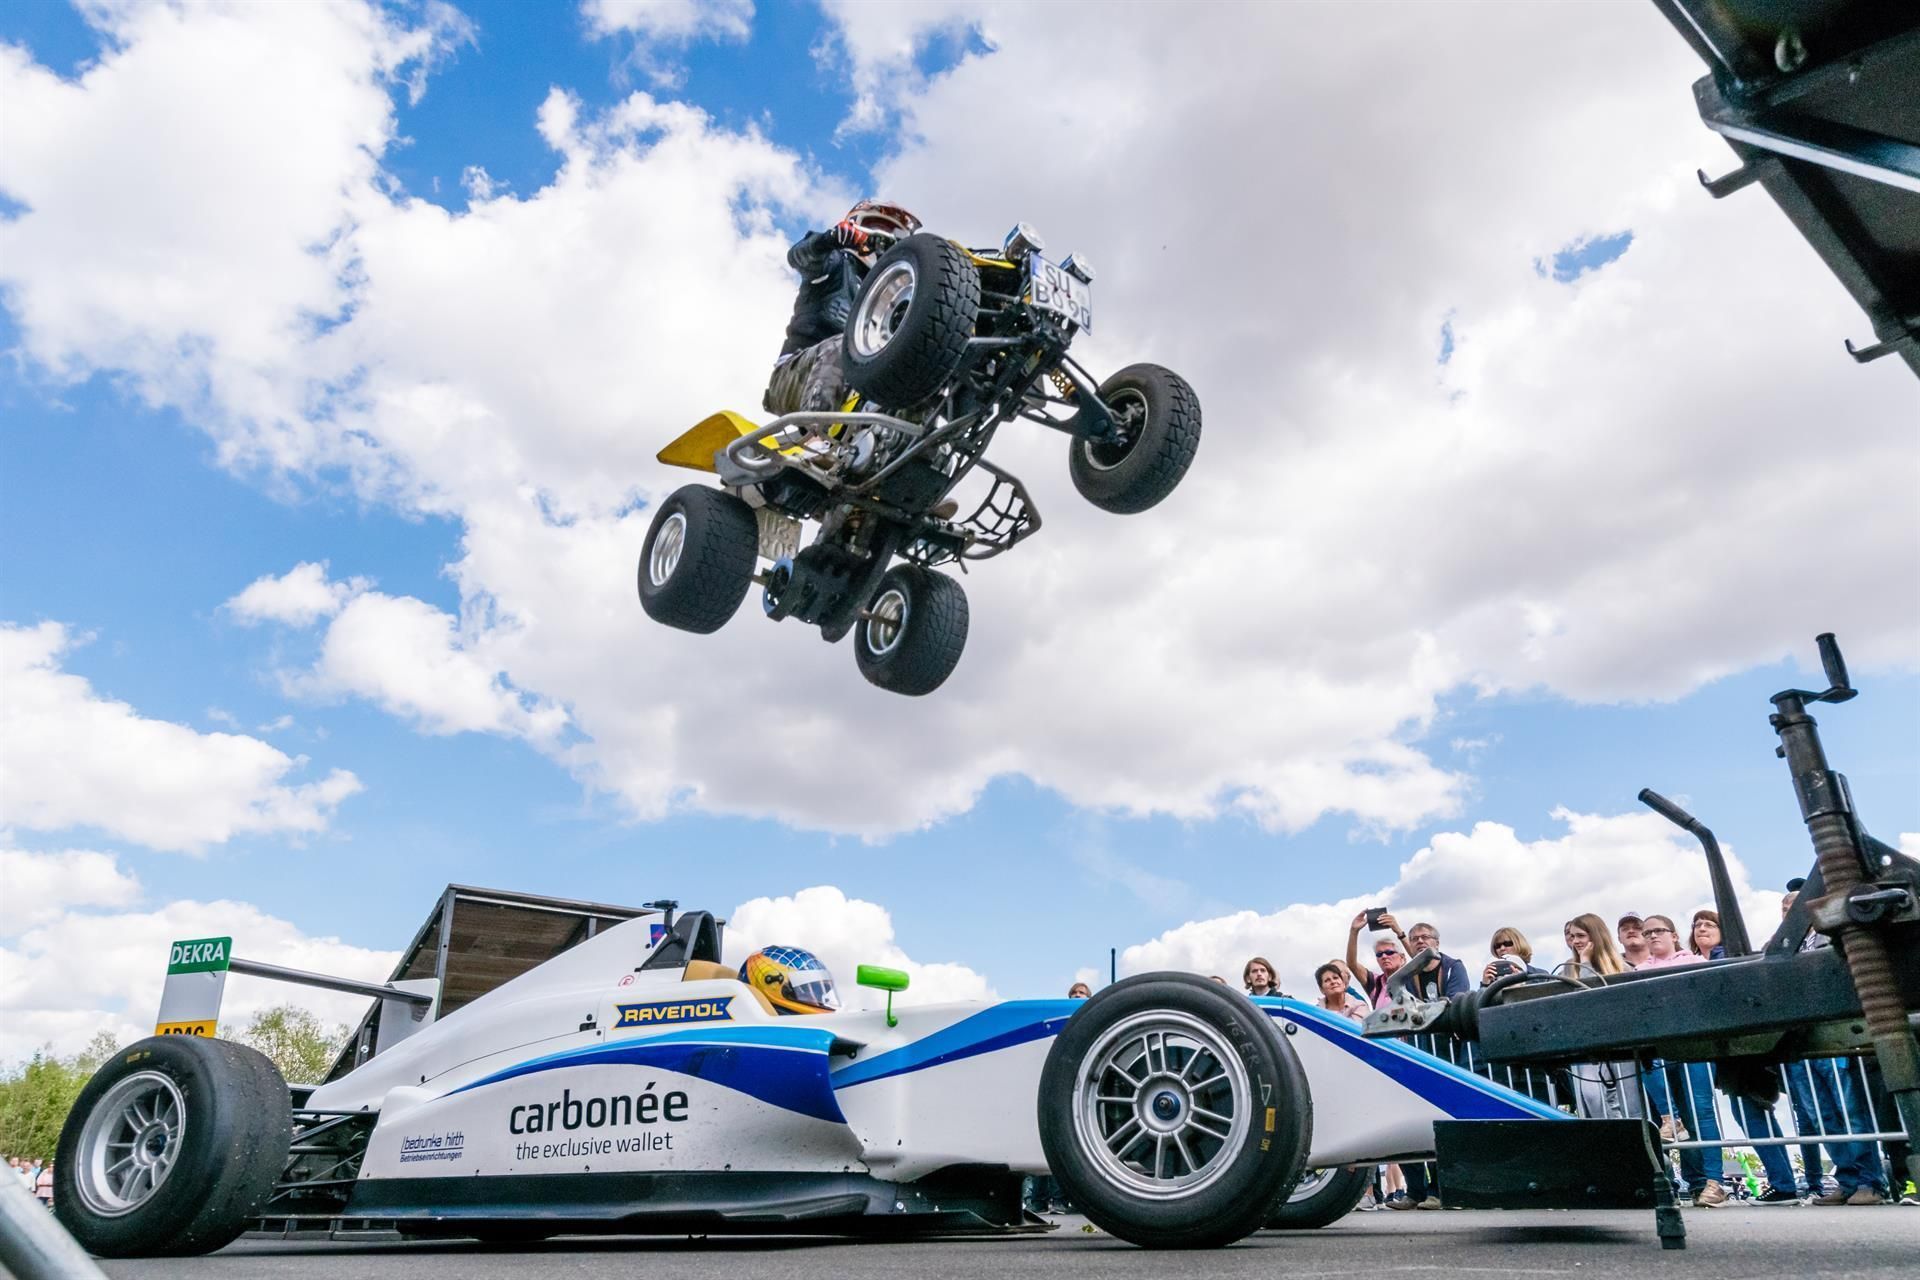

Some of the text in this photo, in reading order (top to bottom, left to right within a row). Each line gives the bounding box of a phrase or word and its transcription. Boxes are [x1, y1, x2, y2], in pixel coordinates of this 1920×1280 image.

[1045, 264, 1070, 293] SU
[170, 941, 224, 965] DEKRA
[624, 1003, 723, 1022] RAVENOL
[510, 1082, 688, 1134] carbonée
[404, 1131, 464, 1150] bedrunka hirth
[516, 1131, 673, 1160] the exclusive wallet
